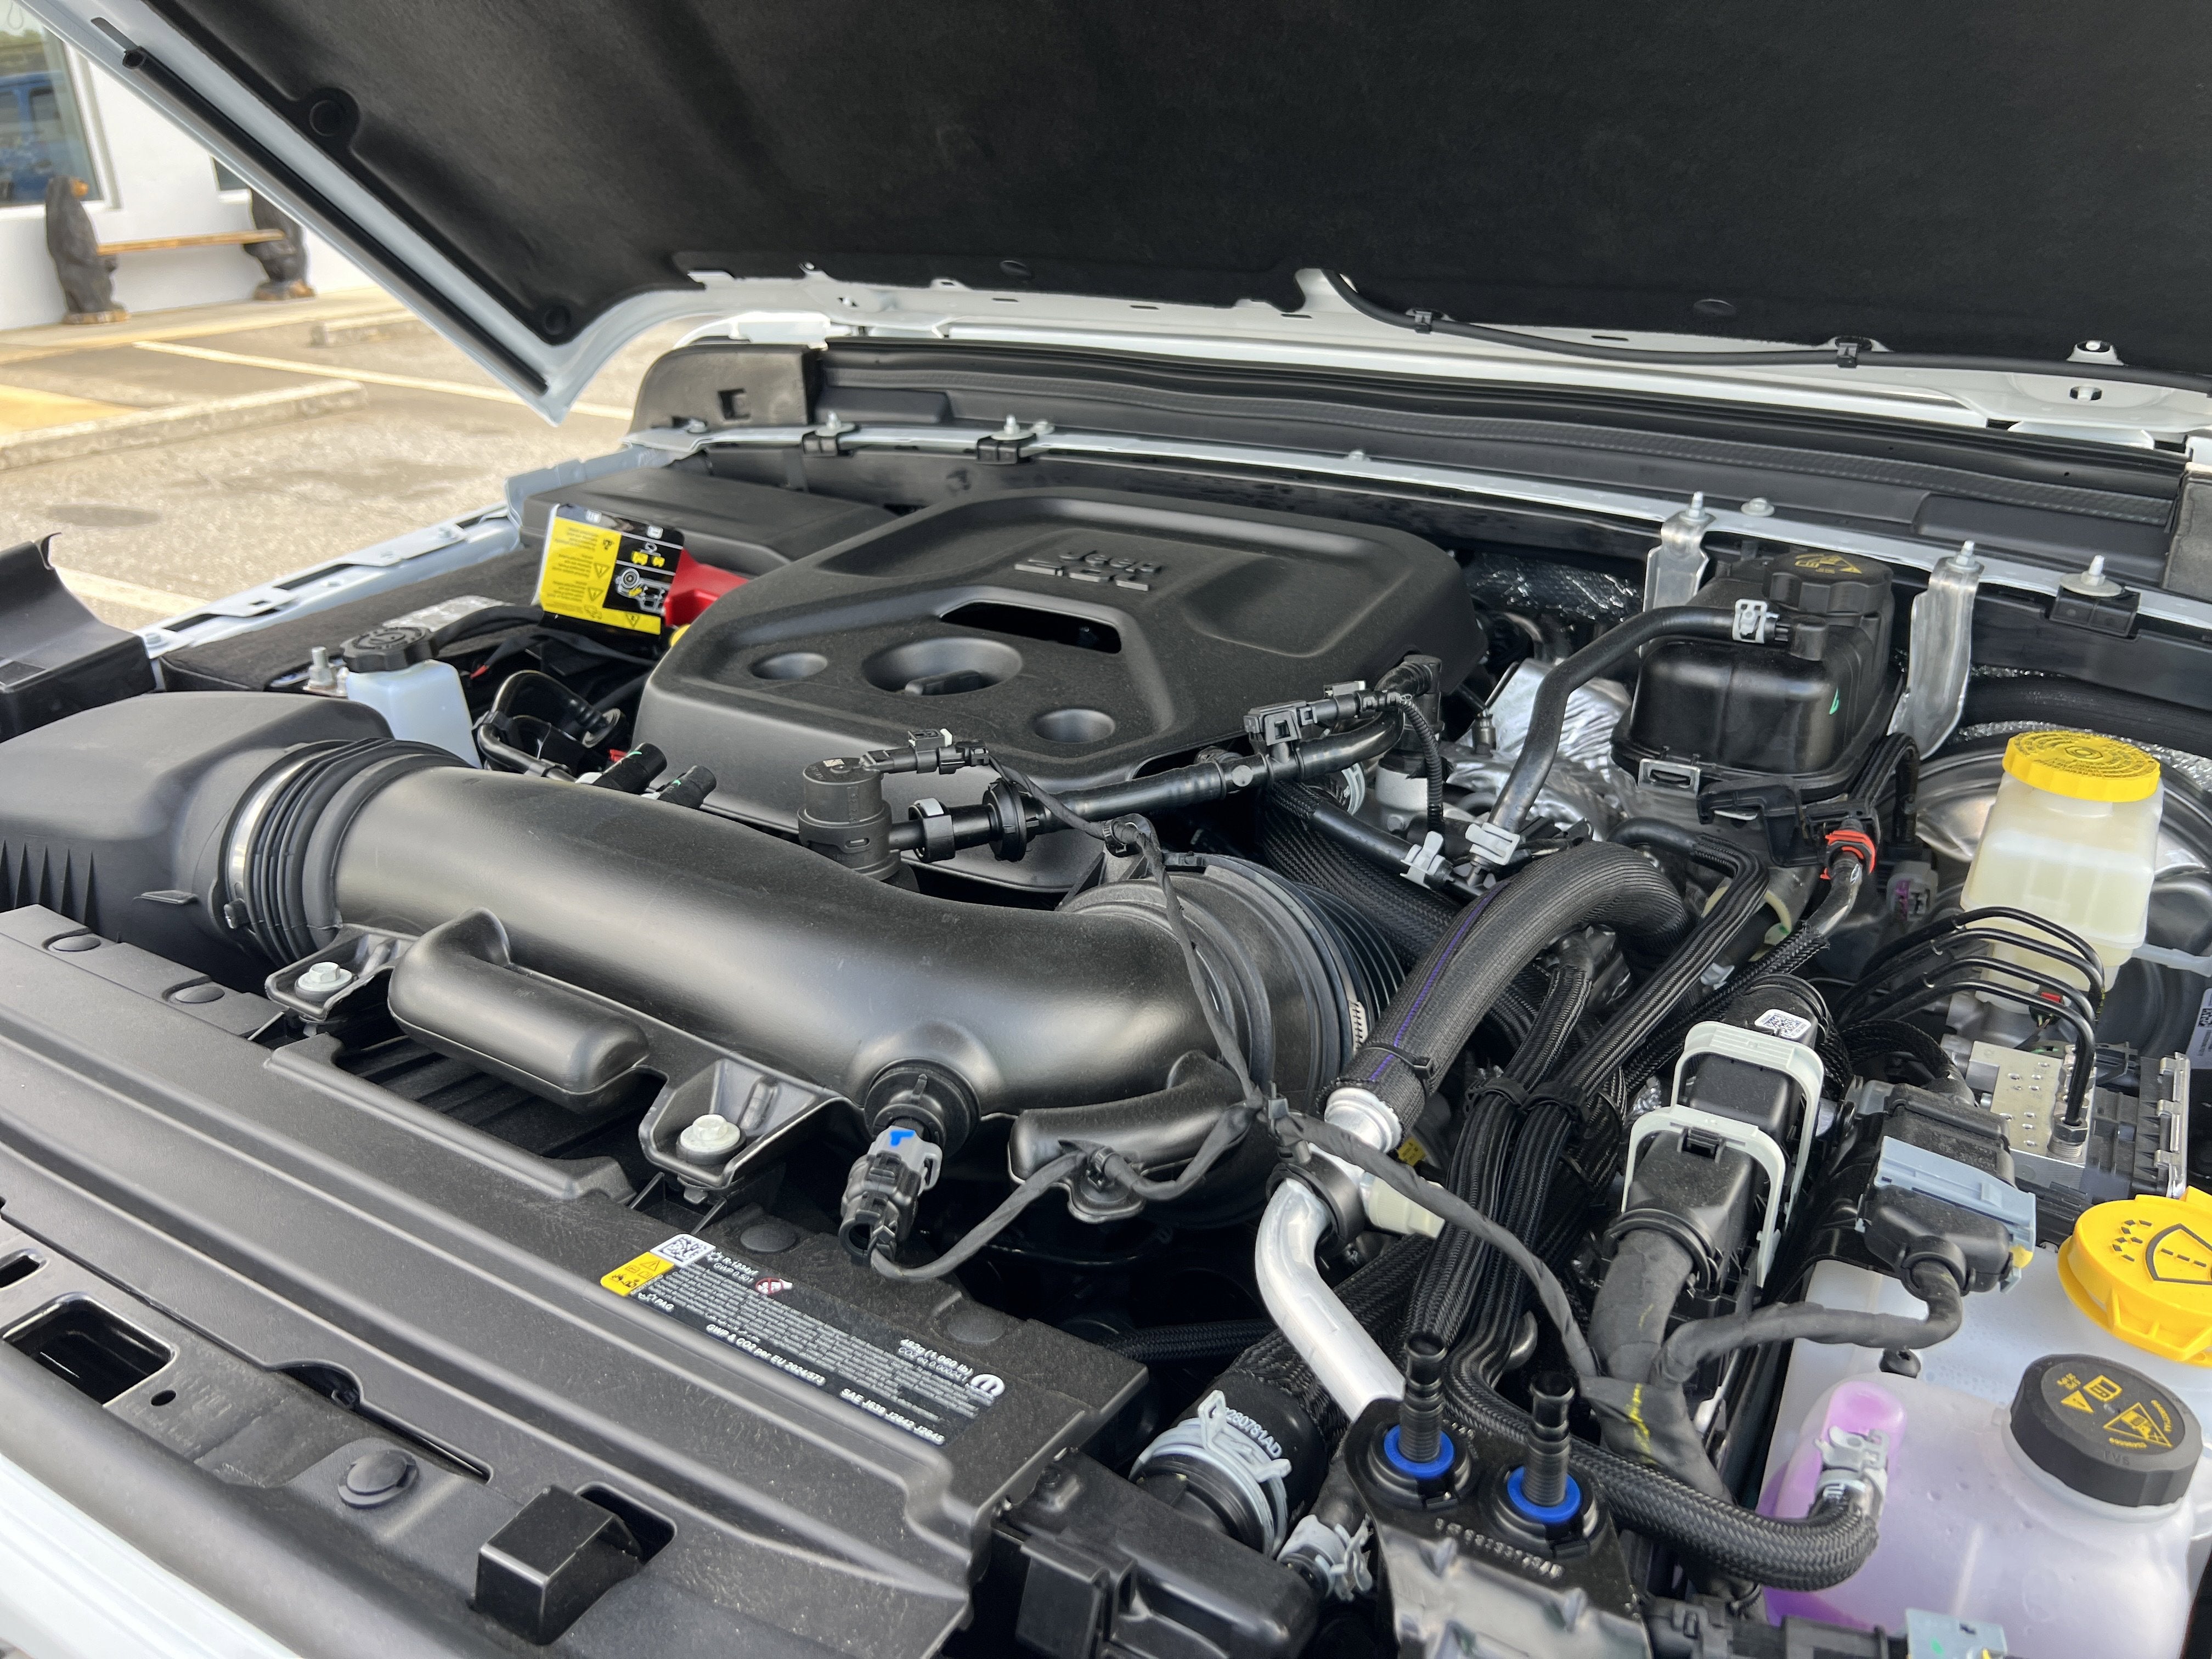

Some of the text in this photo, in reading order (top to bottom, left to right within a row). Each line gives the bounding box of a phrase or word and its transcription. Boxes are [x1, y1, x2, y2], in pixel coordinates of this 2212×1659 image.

[1058, 550, 1161, 573] Jeep
[714, 1262, 755, 1284] GWP 0.501
[722, 1257, 759, 1277] R-1234yf
[654, 1298, 674, 1312] PAG
[706, 1324, 730, 1338] GWP
[727, 1333, 736, 1343] &
[736, 1338, 757, 1352] CO2
[753, 1347, 771, 1360] per
[770, 1355, 787, 1368] EU
[898, 1347, 918, 1361] CO2
[957, 1363, 974, 1377] lb)
[840, 1388, 946, 1445] SAE J639 J2842 J2845
[1225, 1407, 1283, 1459] 280781AD
